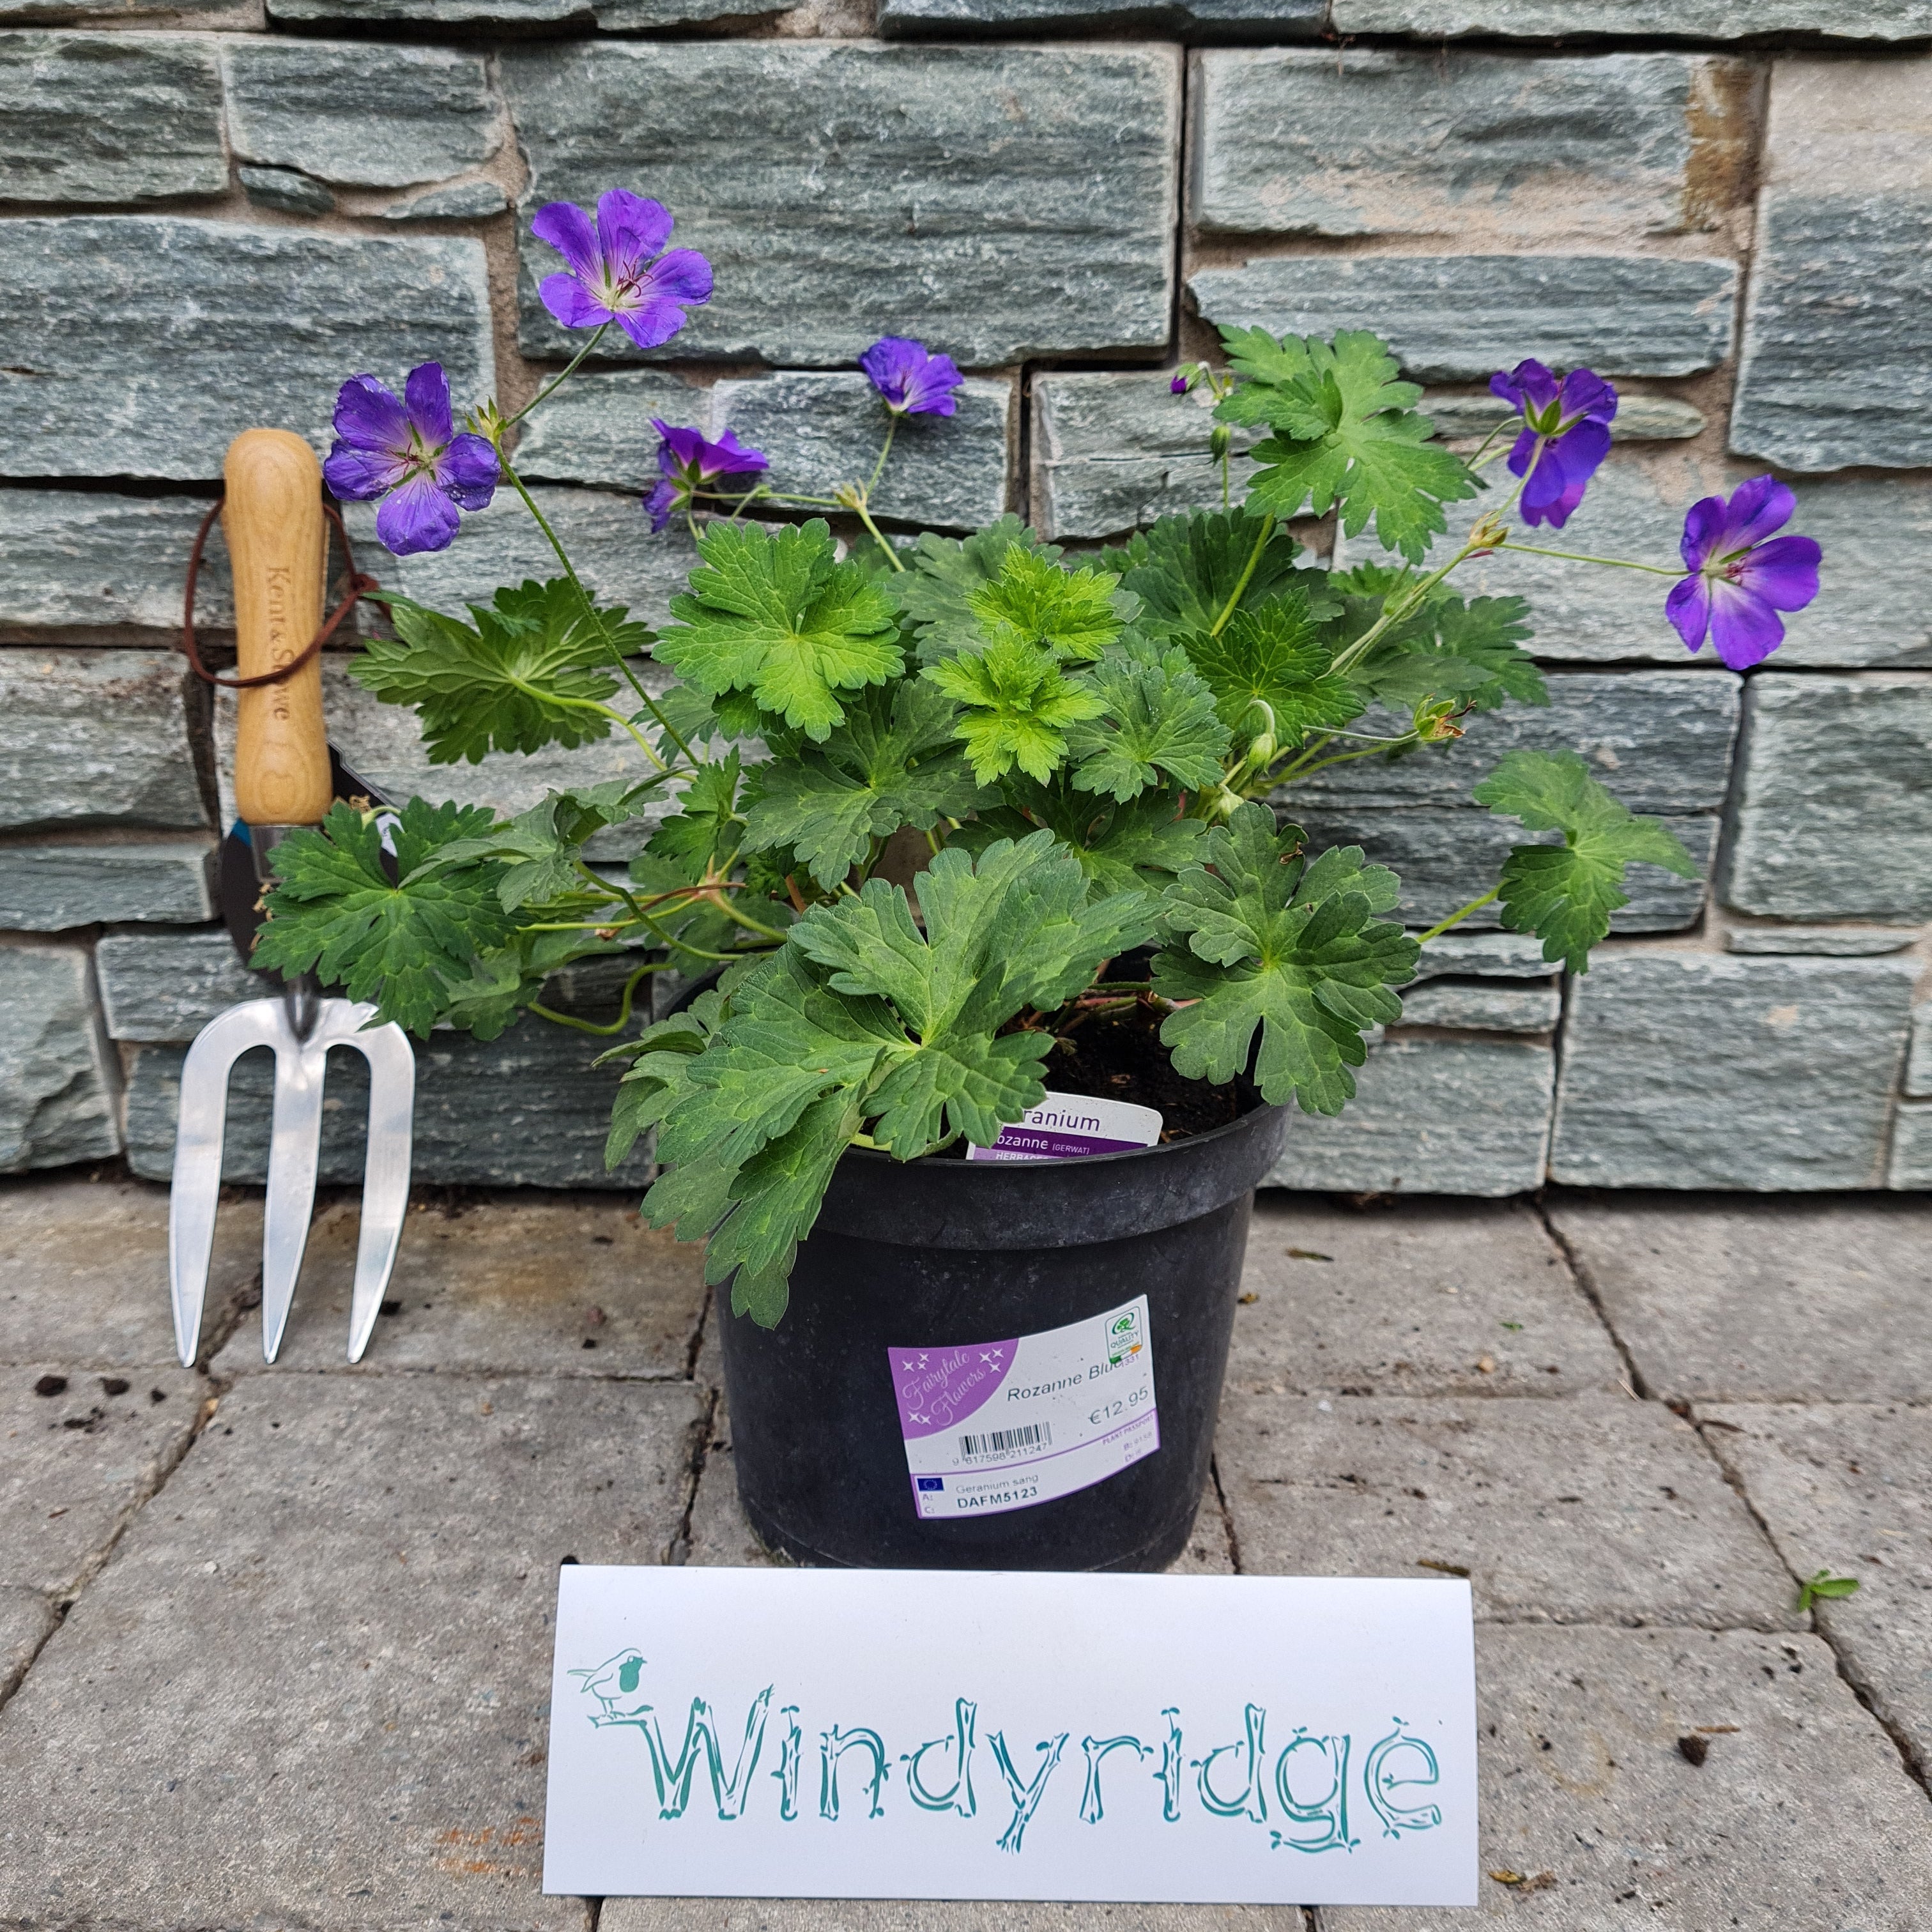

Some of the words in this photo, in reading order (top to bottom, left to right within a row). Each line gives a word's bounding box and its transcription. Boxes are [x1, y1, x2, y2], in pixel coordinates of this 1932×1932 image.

[268, 567, 291, 623] Kent
[270, 629, 282, 643] &
[272, 648, 295, 721] Swe
[1023, 1109, 1101, 1132] ranium
[997, 1134, 1048, 1150] ozanne
[1110, 1330, 1140, 1349] QUALITY
[901, 1349, 970, 1411] Fairytale
[1008, 1374, 1082, 1402] Rozanne
[930, 1367, 986, 1426] Flowers
[1088, 1386, 1149, 1425] €12.95
[955, 1480, 1010, 1494] Geranium
[1013, 1475, 1039, 1487] sang
[957, 1487, 1038, 1508] DAFM5123
[586, 1684, 1443, 1854] Windyridge
